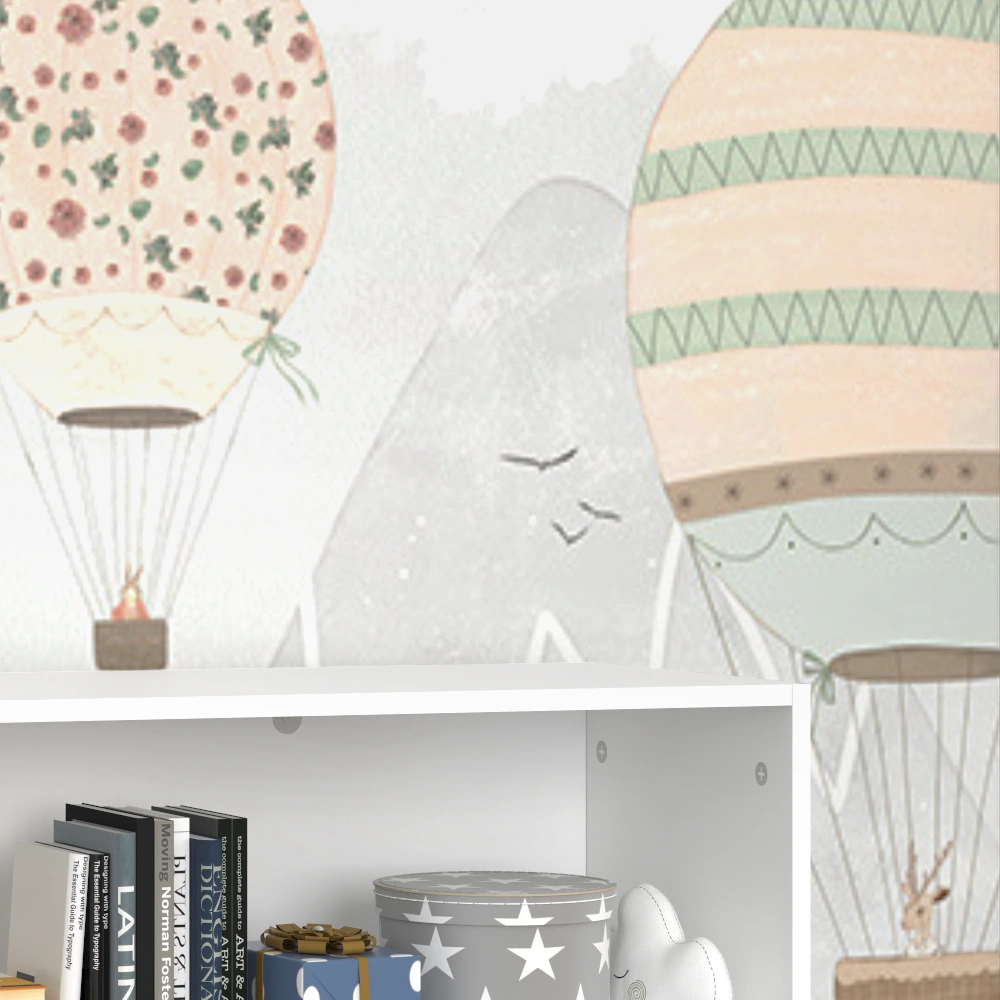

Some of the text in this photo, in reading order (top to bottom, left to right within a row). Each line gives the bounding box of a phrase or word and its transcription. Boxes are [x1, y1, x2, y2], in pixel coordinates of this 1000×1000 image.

[159, 823, 171, 882] Moving
[235, 836, 243, 850] the
[70, 873, 78, 903] Essential
[79, 856, 89, 895] Designing
[235, 853, 243, 893] complete
[161, 886, 171, 954] Norman
[235, 894, 243, 917] guide
[221, 919, 228, 931] to
[235, 918, 243, 930] to
[65, 933, 74, 971] Typography
[221, 936, 229, 971] ART
[235, 934, 245, 971] ART
[221, 975, 229, 990] &
[235, 975, 245, 989] &
